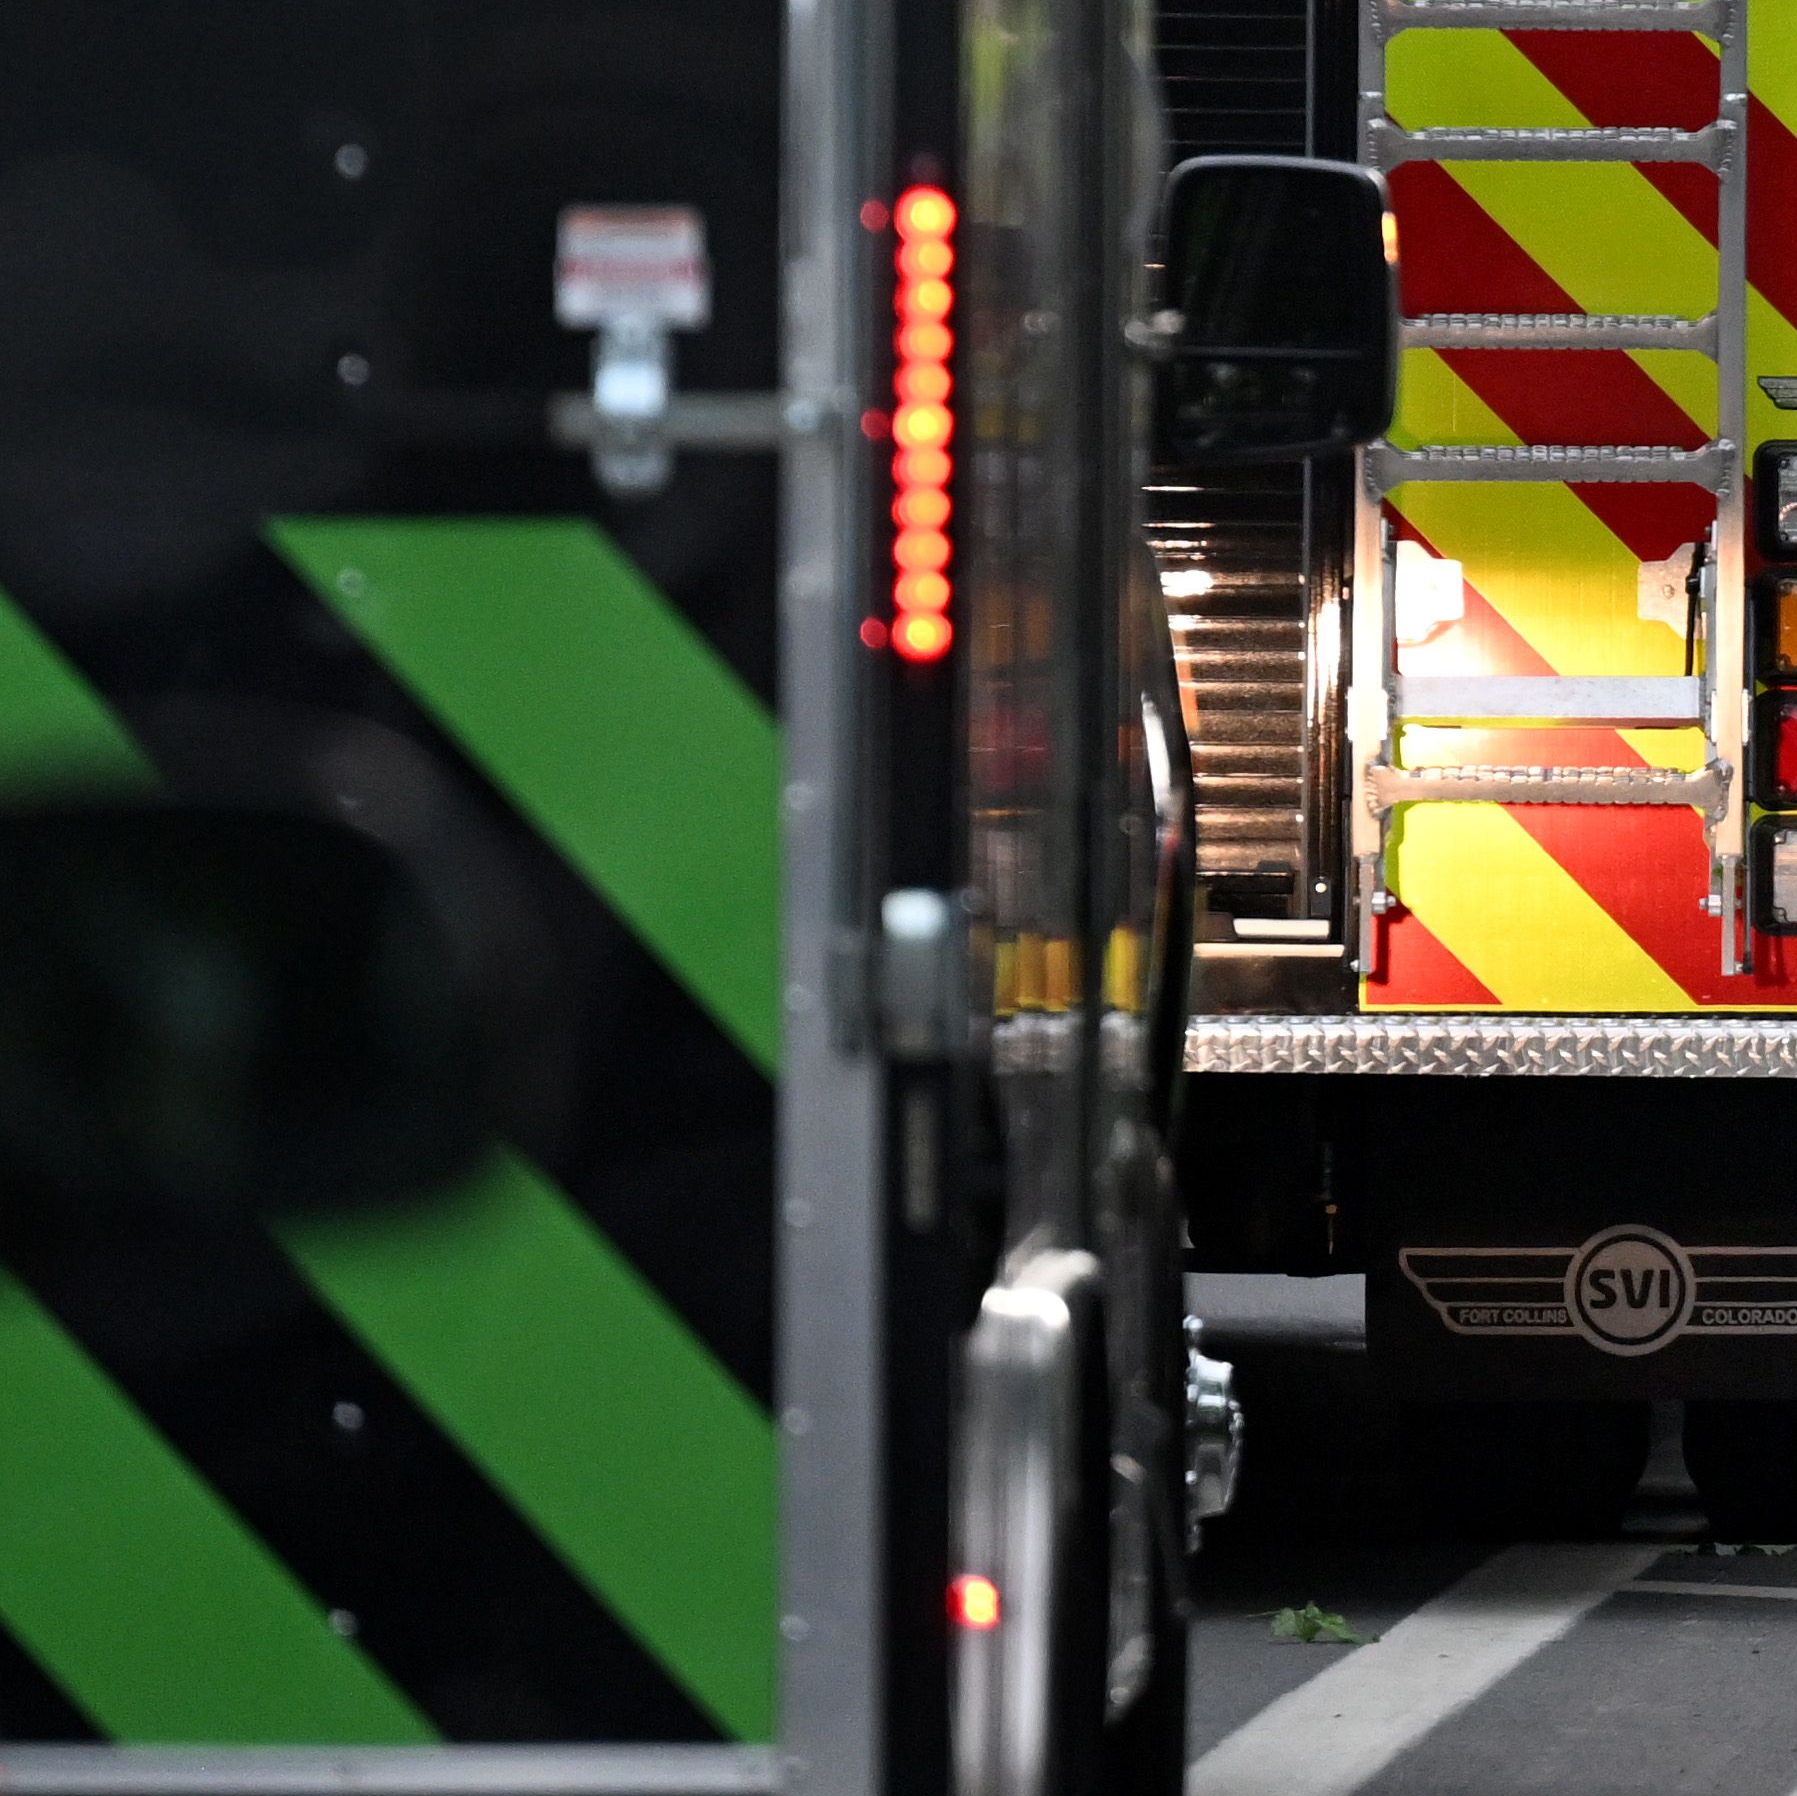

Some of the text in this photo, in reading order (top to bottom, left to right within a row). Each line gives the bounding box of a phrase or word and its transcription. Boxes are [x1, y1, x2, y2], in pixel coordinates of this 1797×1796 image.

[1588, 1268, 1671, 1310] SVI
[1459, 1308, 1499, 1325] FORT
[1502, 1308, 1568, 1326] COLLINS
